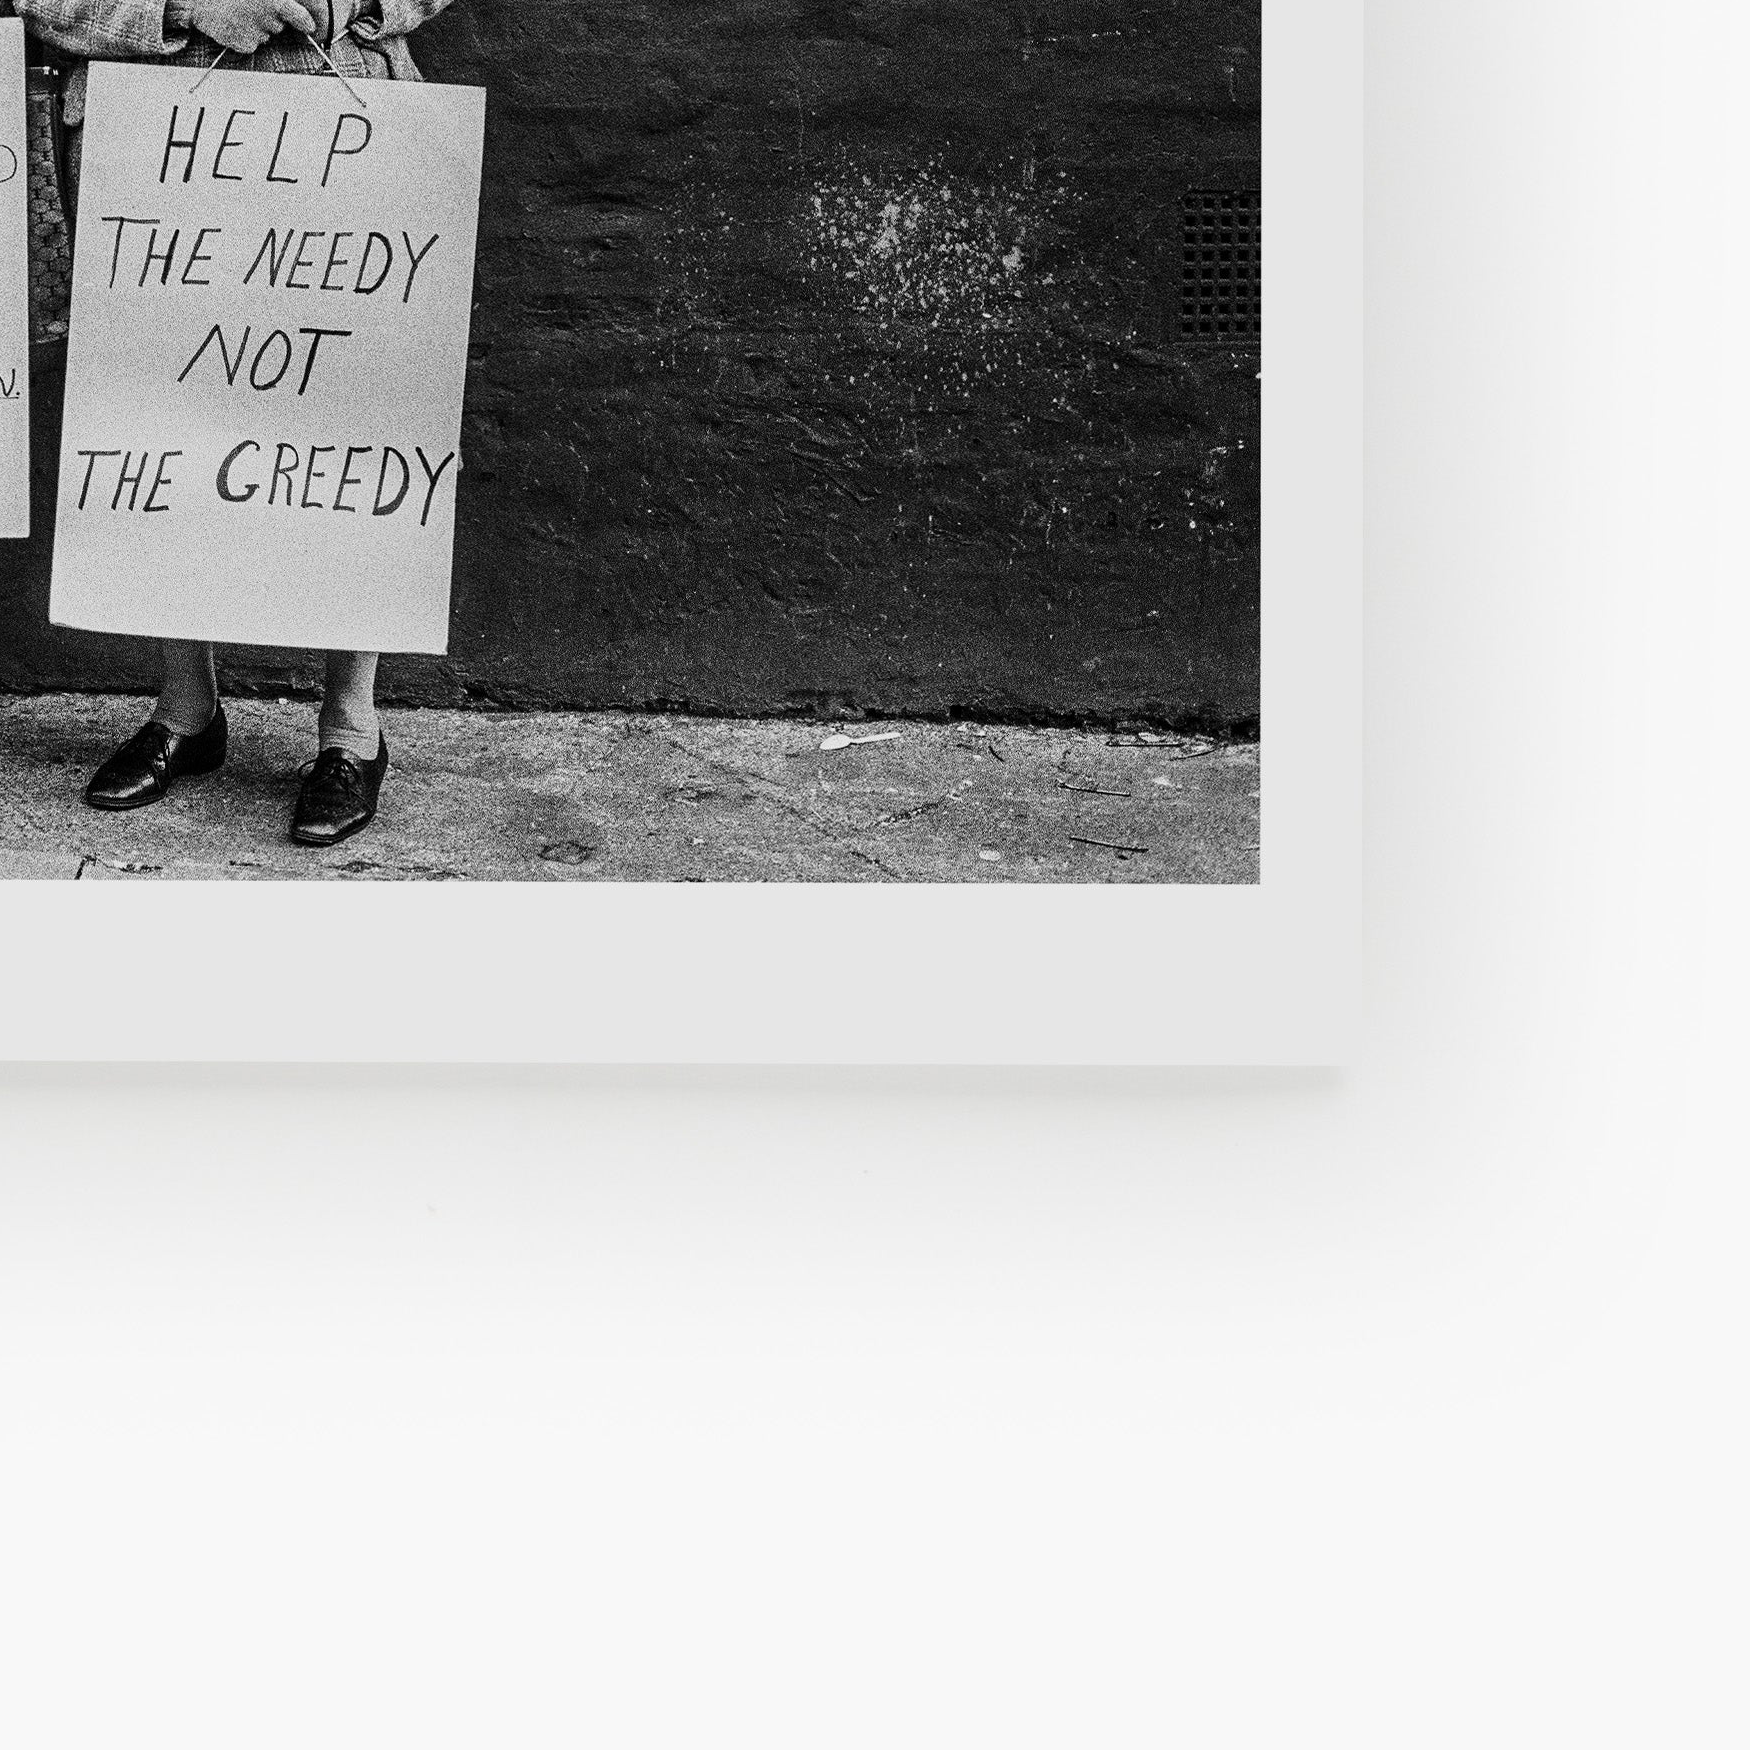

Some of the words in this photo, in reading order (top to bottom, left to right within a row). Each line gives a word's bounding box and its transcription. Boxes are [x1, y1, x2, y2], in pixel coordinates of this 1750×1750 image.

[159, 105, 373, 187] HELP
[102, 216, 222, 289] THE
[243, 227, 440, 304] NEEDY
[177, 324, 352, 396] NOT
[77, 450, 183, 513] THE
[216, 440, 455, 527] GREEDY
